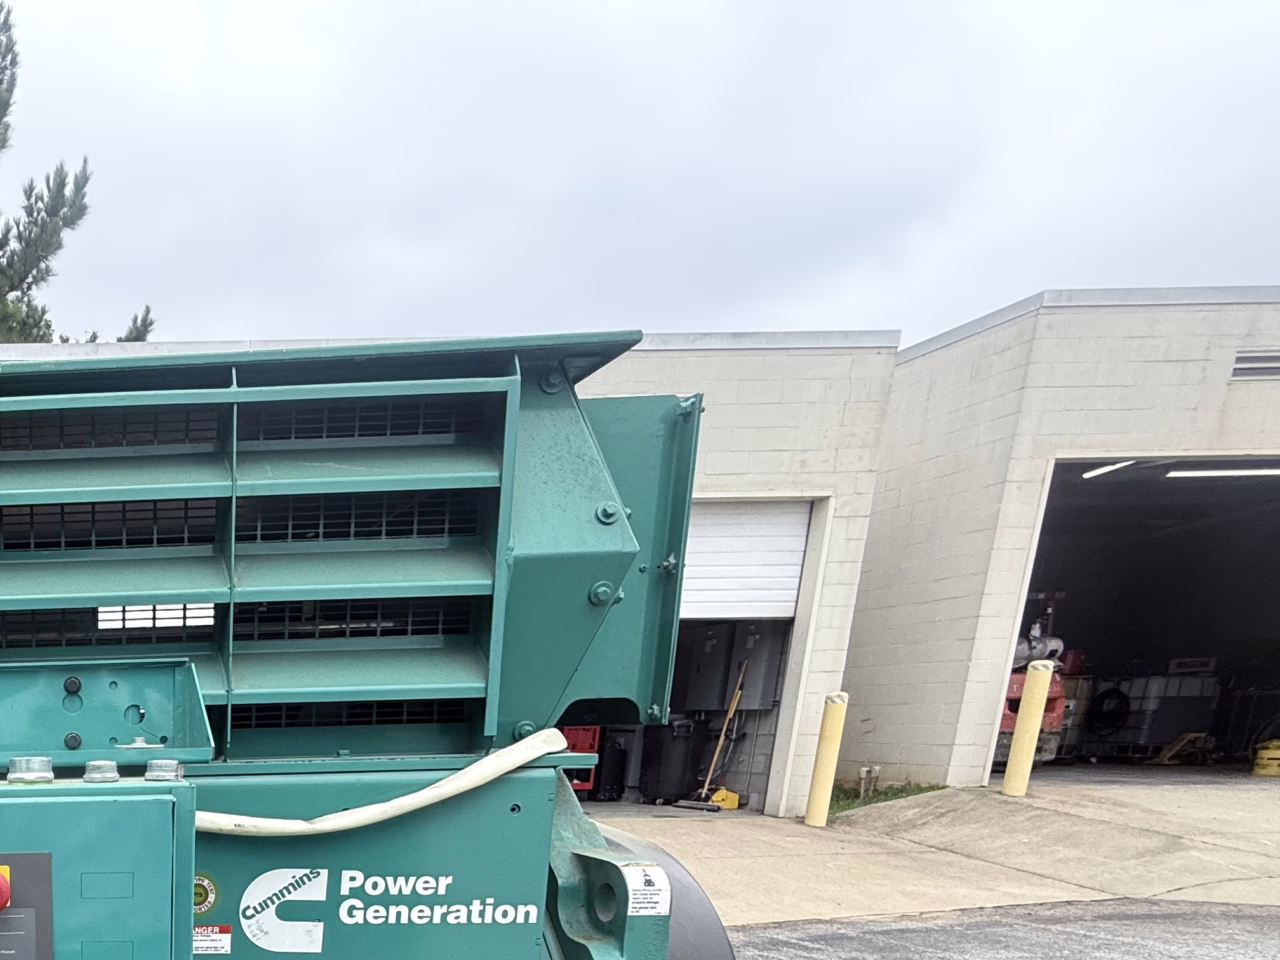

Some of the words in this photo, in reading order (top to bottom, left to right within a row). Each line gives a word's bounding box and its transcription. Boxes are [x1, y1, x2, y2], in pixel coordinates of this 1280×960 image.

[241, 868, 321, 921] Cummins
[340, 869, 453, 896] Power
[338, 898, 538, 925] Generation
[194, 926, 220, 934] NGER
